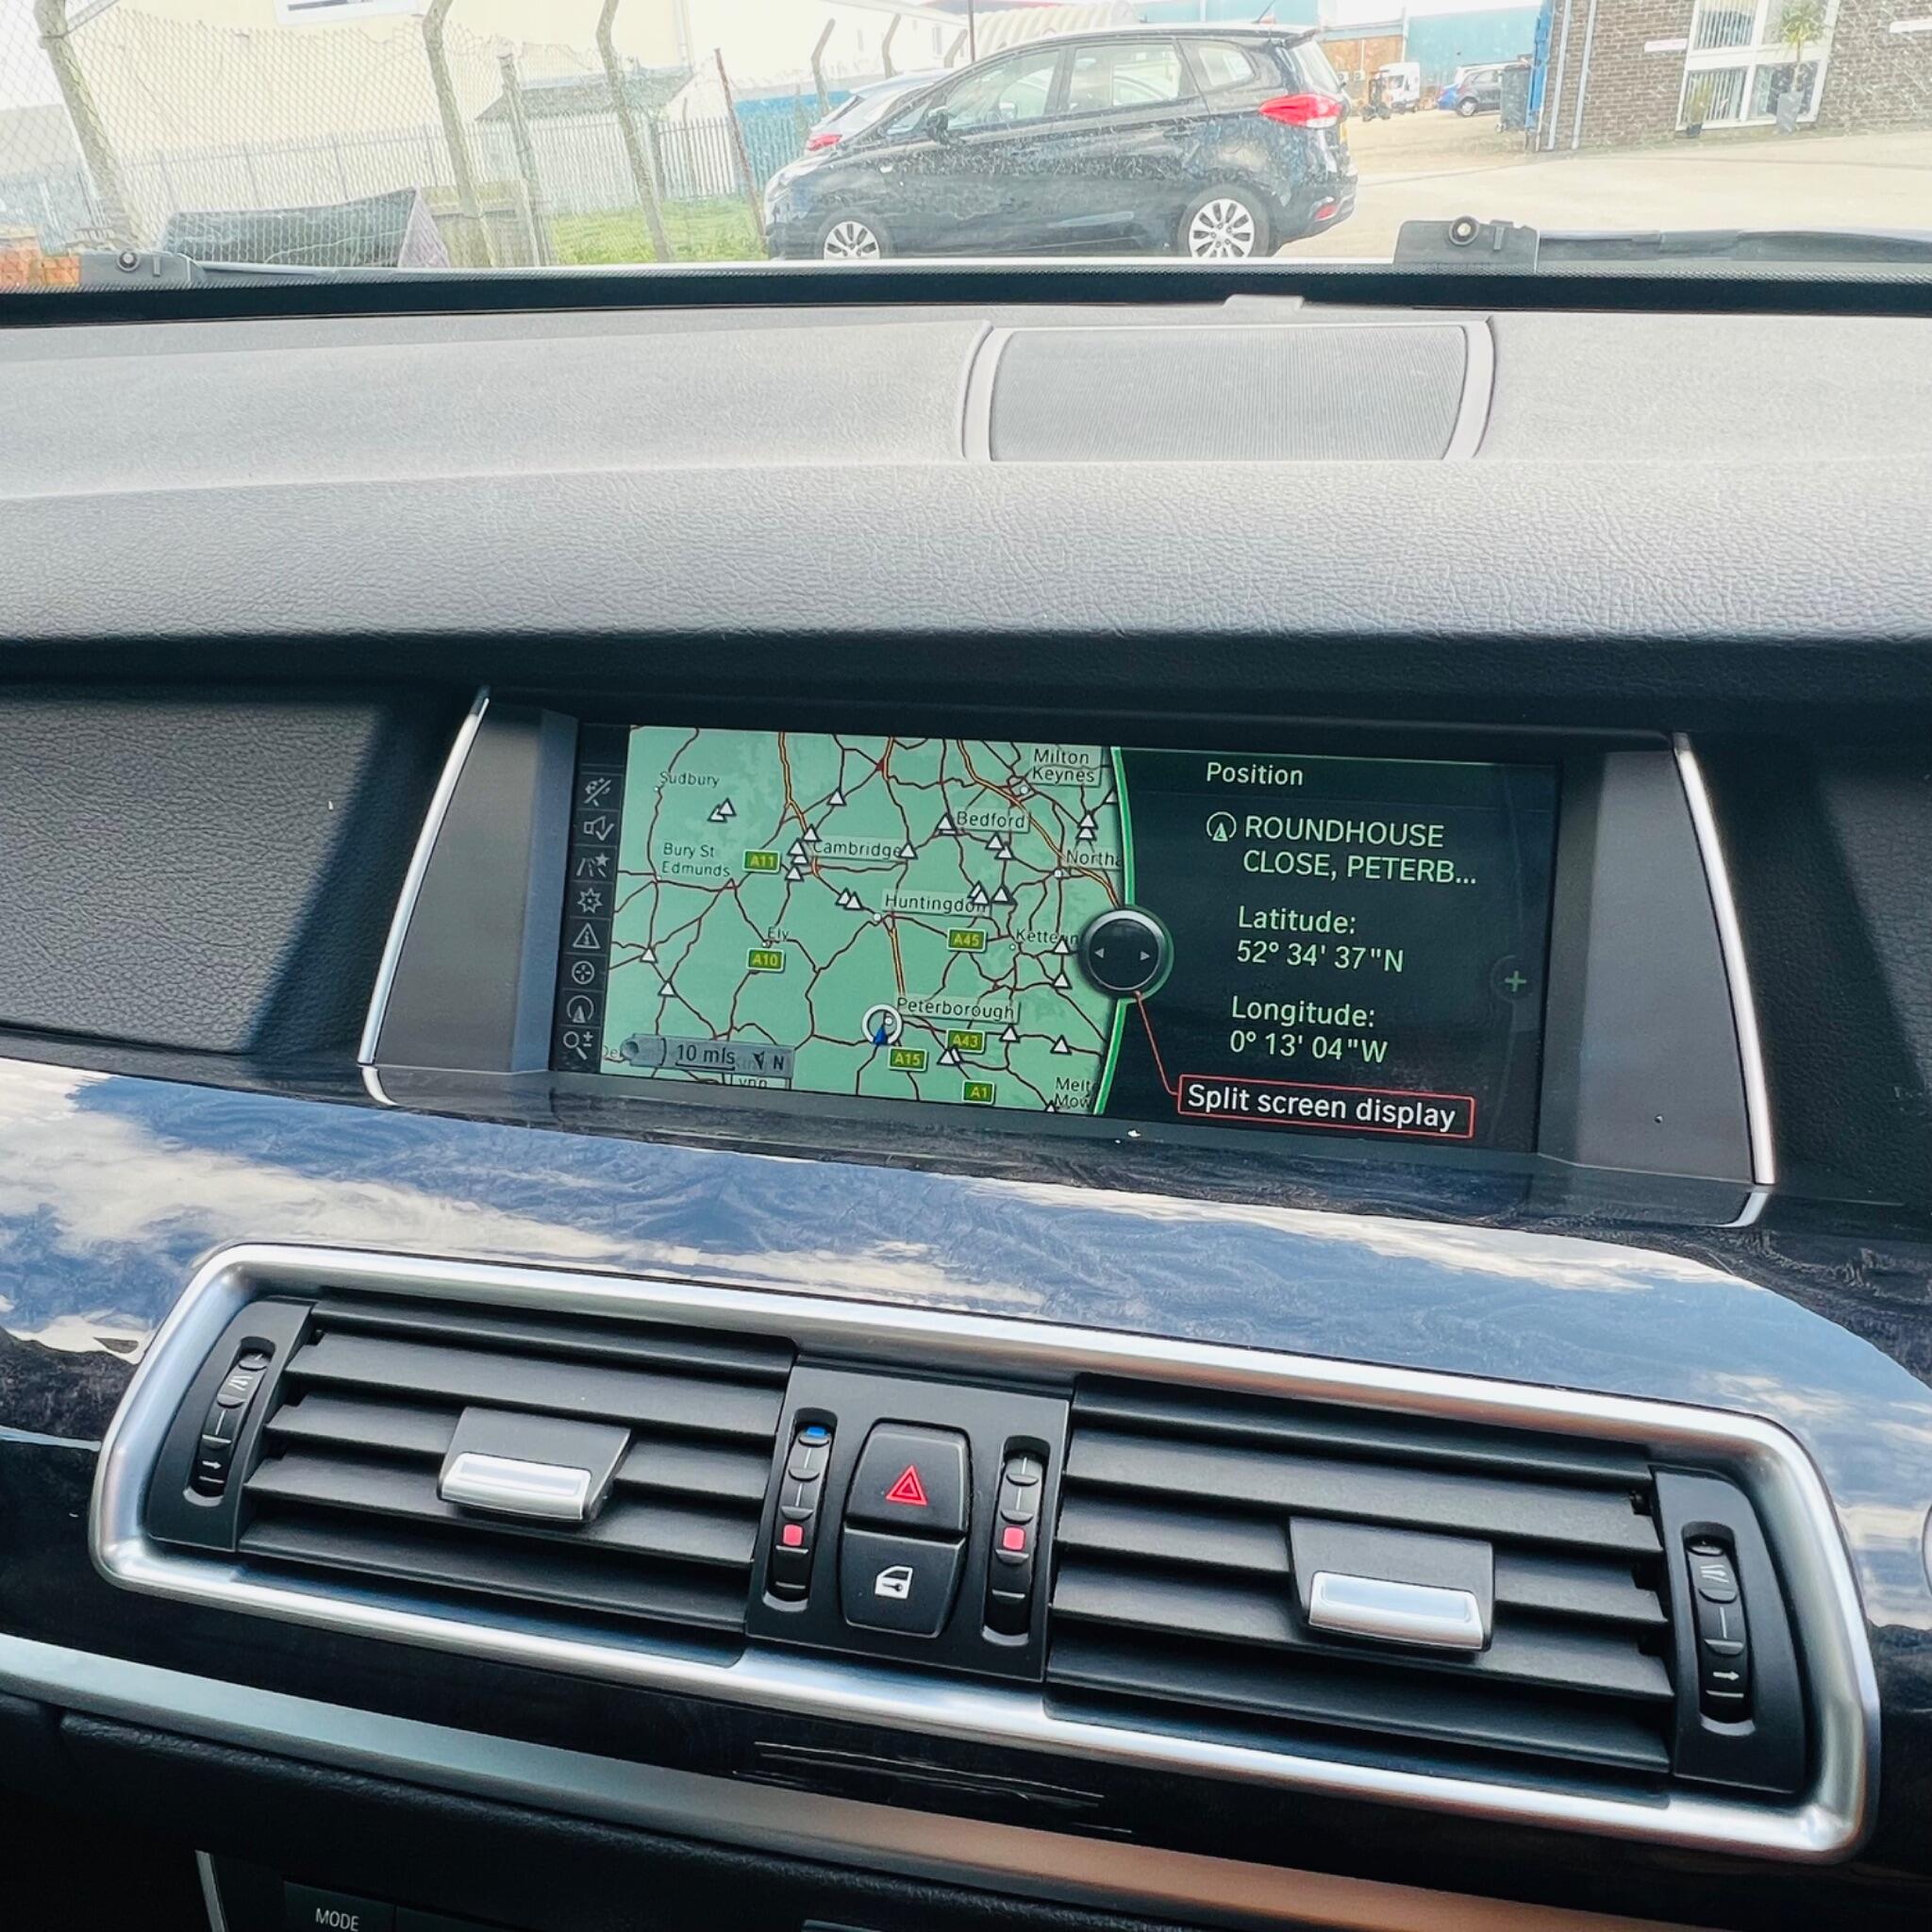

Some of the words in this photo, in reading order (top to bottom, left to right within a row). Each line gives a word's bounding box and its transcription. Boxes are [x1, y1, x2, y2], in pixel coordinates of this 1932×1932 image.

[1033, 747, 1090, 765] Milton
[660, 772, 720, 789] Sudbury
[1032, 766, 1095, 784] Keynes
[1207, 761, 1304, 786] Position
[956, 810, 1025, 829] Bedford
[1244, 814, 1445, 848] ROUNDHOUSE
[663, 842, 694, 859] Bury
[699, 844, 715, 858] St
[813, 841, 901, 860] Cambridge
[661, 860, 730, 878] Edmunds
[749, 856, 774, 869] A11
[1242, 849, 1338, 882] CLOSE,
[1347, 855, 1477, 885] PETERB...
[885, 894, 987, 914] Huntingdon
[1238, 905, 1357, 935] Latitude:
[767, 926, 790, 941] Ely
[953, 933, 980, 947] A45
[752, 954, 778, 968] A10
[1236, 940, 1280, 964] 52°
[1286, 942, 1326, 967] 34'
[897, 997, 1015, 1021] Peterborough
[1231, 994, 1375, 1028] Longitude:
[952, 1034, 978, 1047] A43
[1229, 1030, 1257, 1053] 0°
[1265, 1032, 1304, 1058] 13'
[677, 1043, 697, 1062] 10
[703, 1046, 736, 1065] mls
[893, 1052, 921, 1066] A15
[970, 1086, 988, 1098] A1
[1187, 1083, 1250, 1114] Split
[1257, 1091, 1347, 1121] screen
[1355, 1098, 1457, 1133] display
[315, 1907, 360, 1932] MODE
